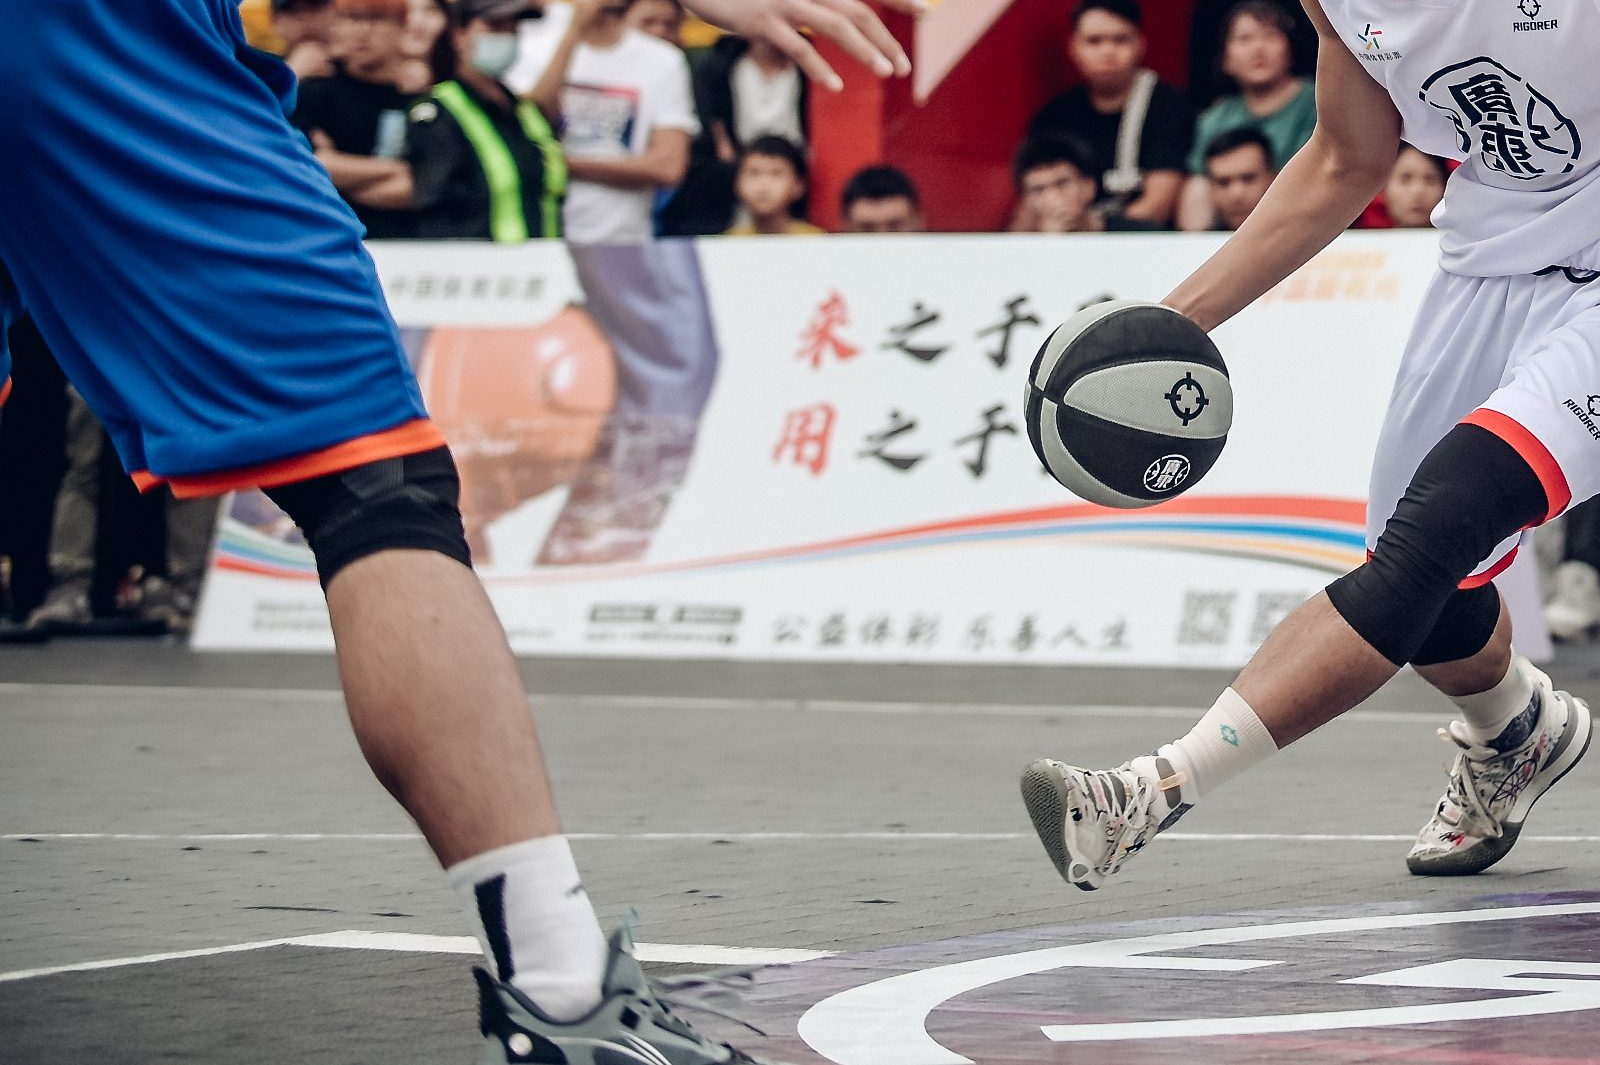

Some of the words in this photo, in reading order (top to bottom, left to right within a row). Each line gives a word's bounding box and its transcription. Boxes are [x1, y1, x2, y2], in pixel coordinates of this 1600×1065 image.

[1513, 19, 1558, 33] RIGORER
[771, 401, 1050, 478] 用之于
